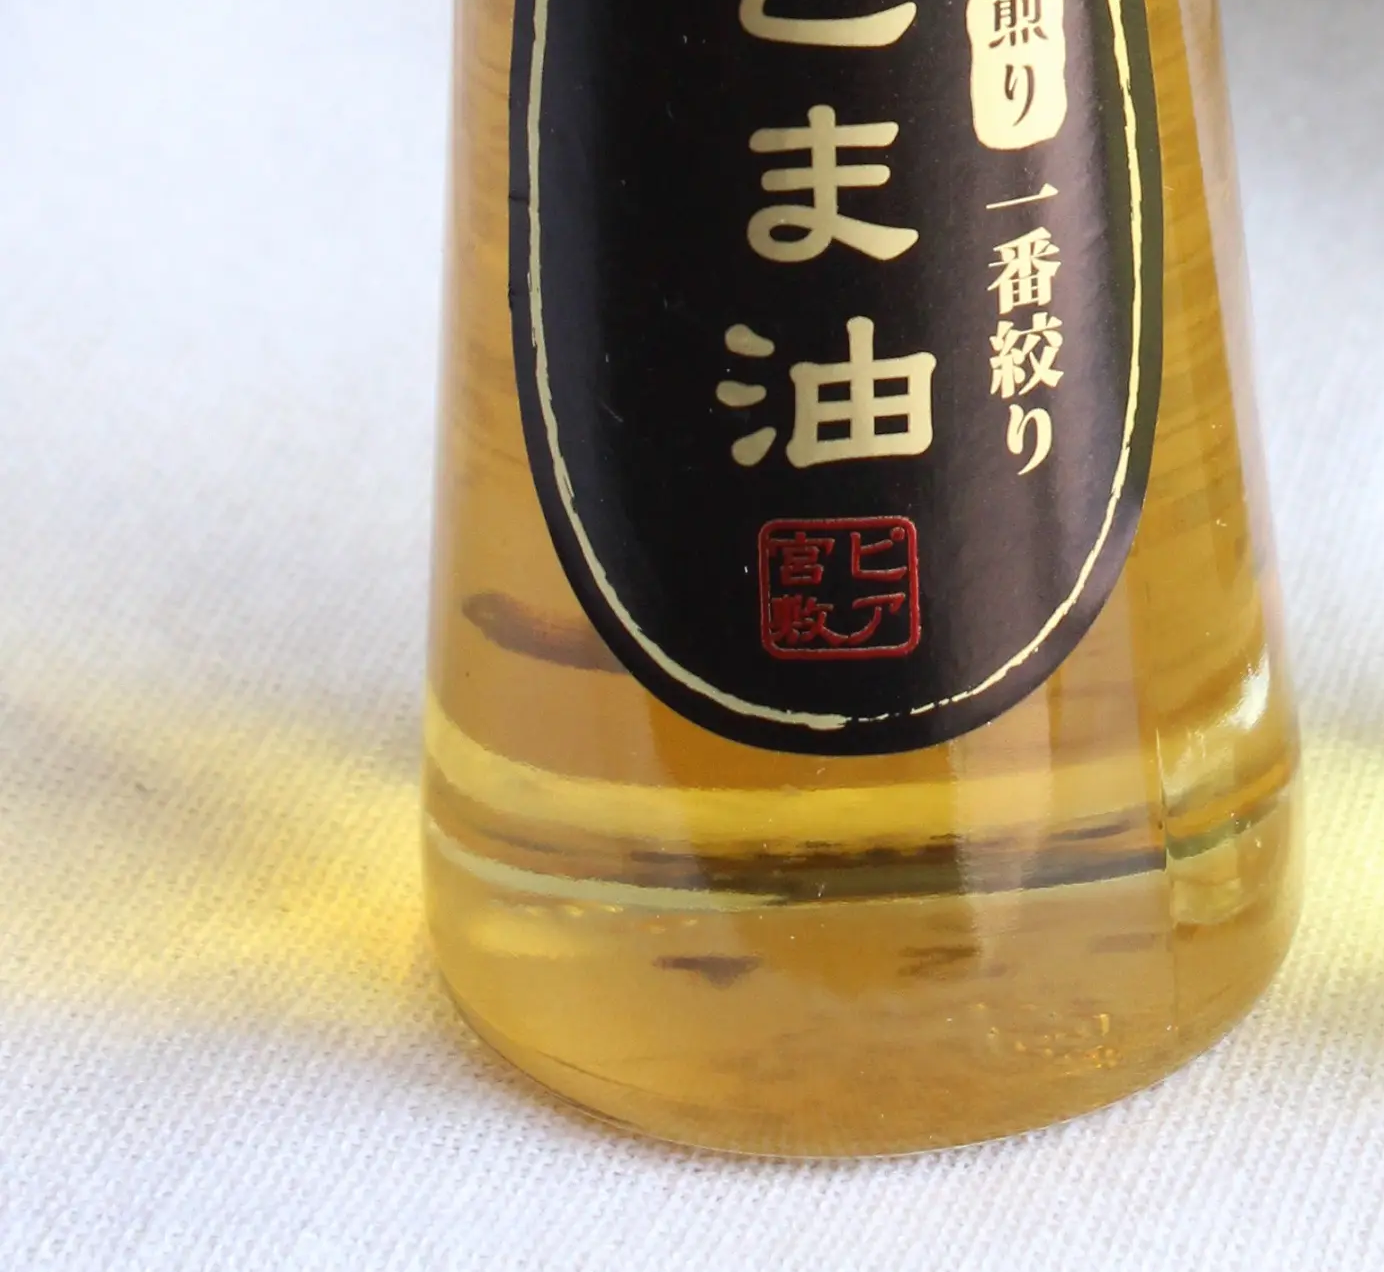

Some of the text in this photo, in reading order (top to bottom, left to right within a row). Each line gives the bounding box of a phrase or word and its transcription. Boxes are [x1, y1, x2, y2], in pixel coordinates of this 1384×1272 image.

[985, 182, 1065, 476] 一番絞り
[848, 526, 908, 645] ピア
